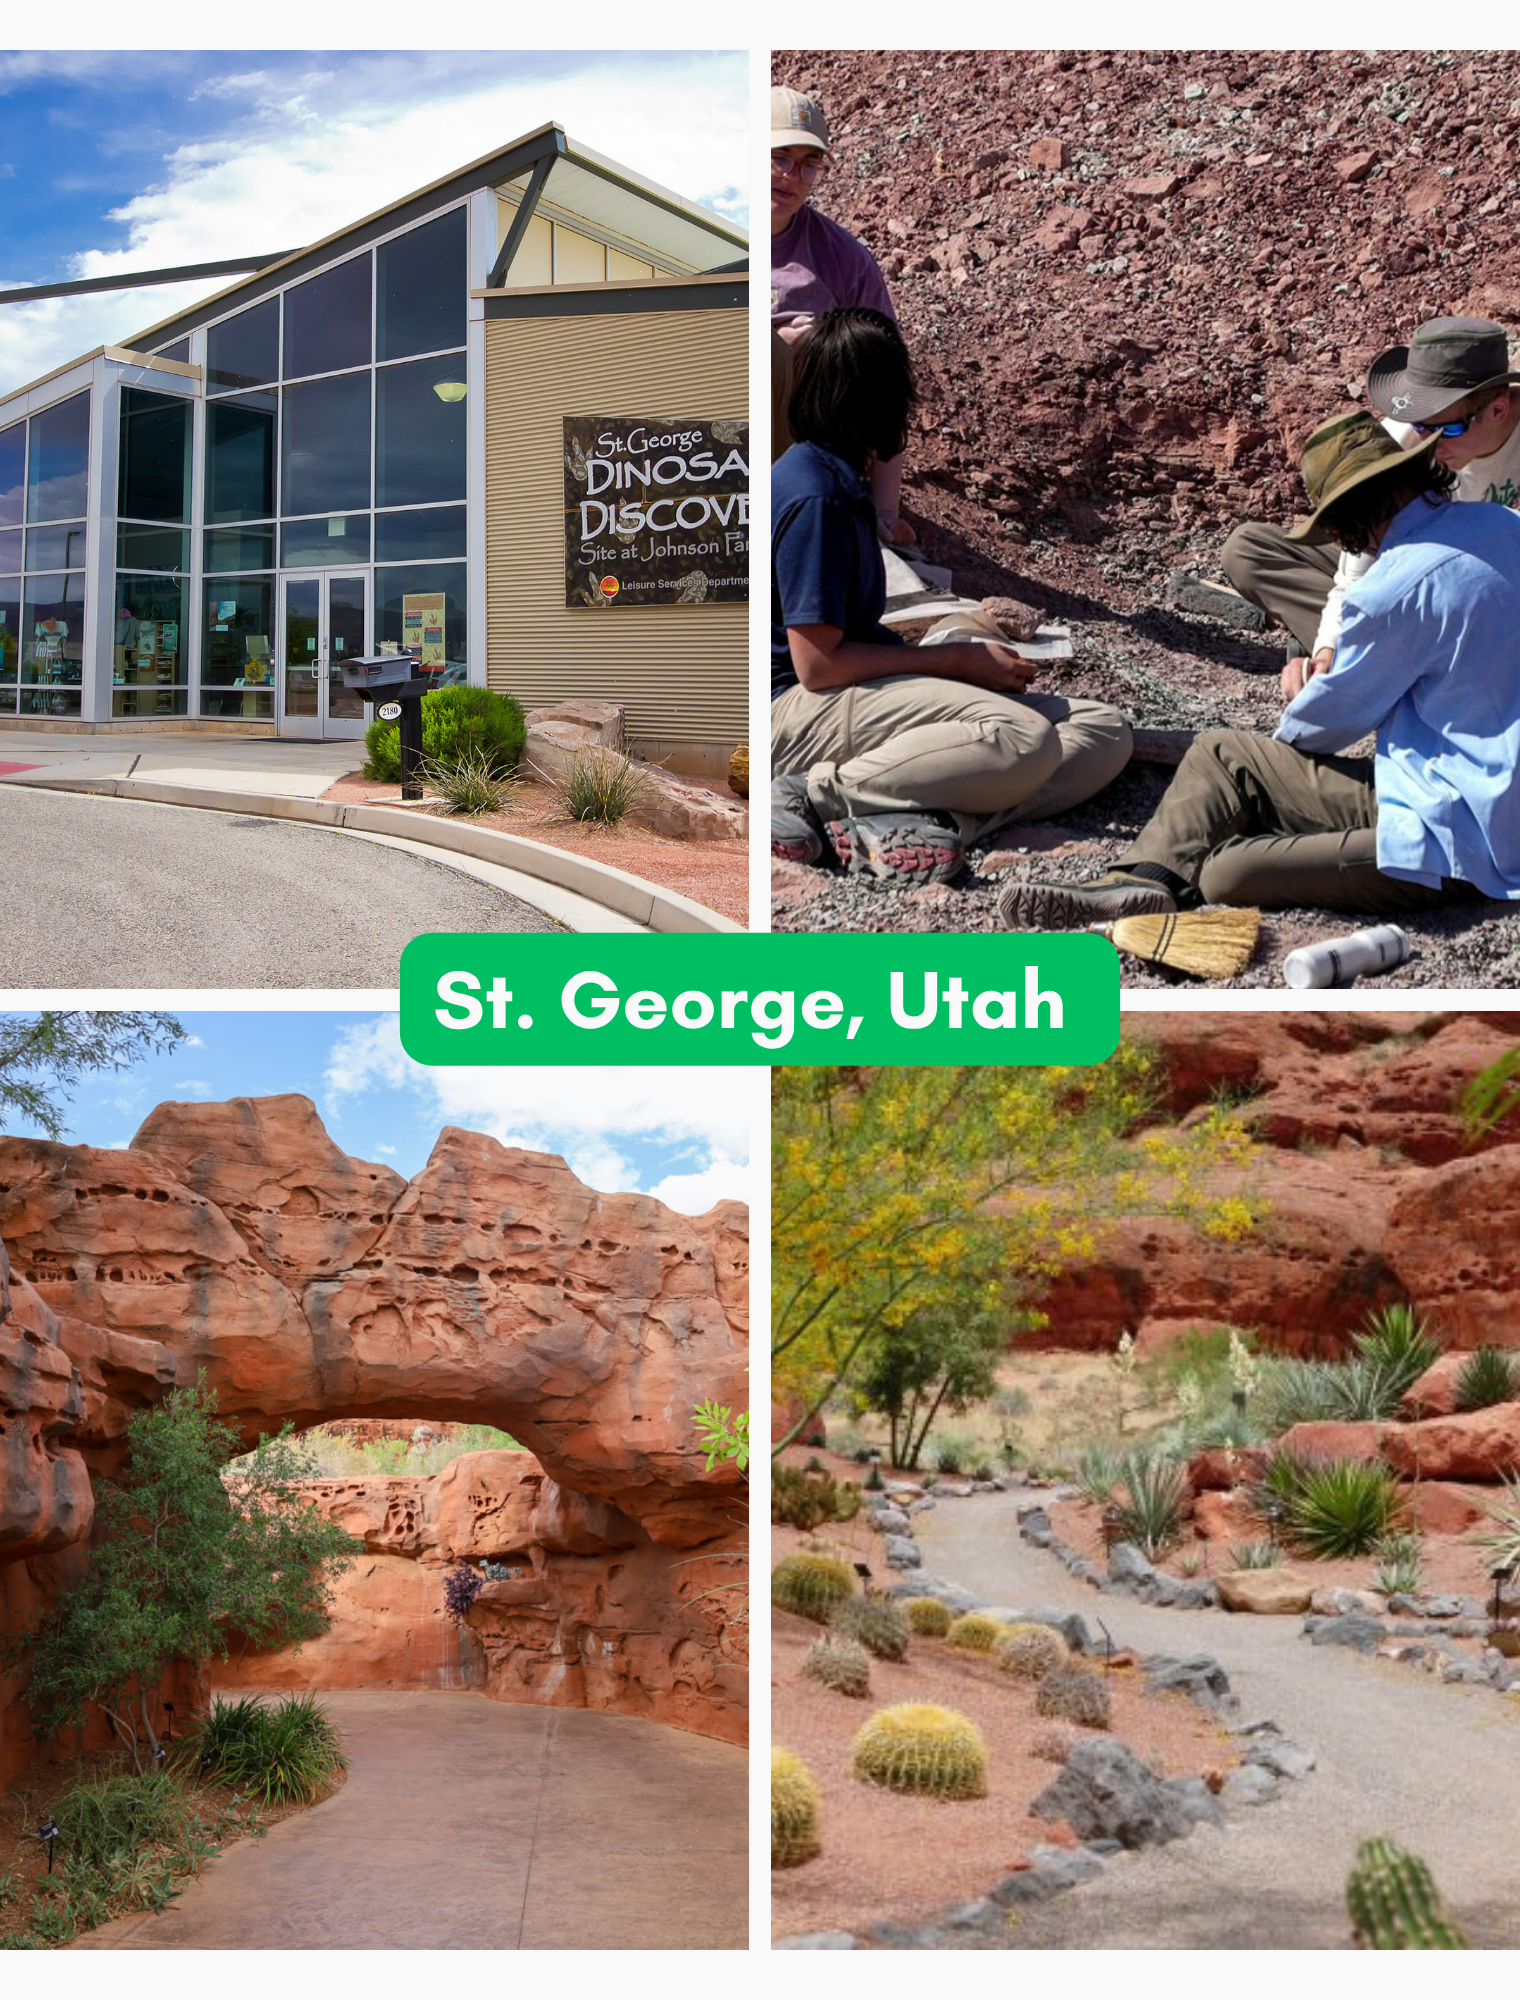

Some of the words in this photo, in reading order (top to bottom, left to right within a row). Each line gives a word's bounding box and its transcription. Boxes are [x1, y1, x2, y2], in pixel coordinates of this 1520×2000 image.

[586, 449, 749, 495] DINOSA
[580, 493, 749, 540] DISCOVE
[578, 541, 617, 565] Site
[621, 544, 638, 559] at
[640, 535, 719, 562] Johnson
[622, 581, 656, 590] Leisure
[658, 578, 699, 589] Services
[701, 576, 749, 588] Departme
[381, 706, 398, 716] 2180
